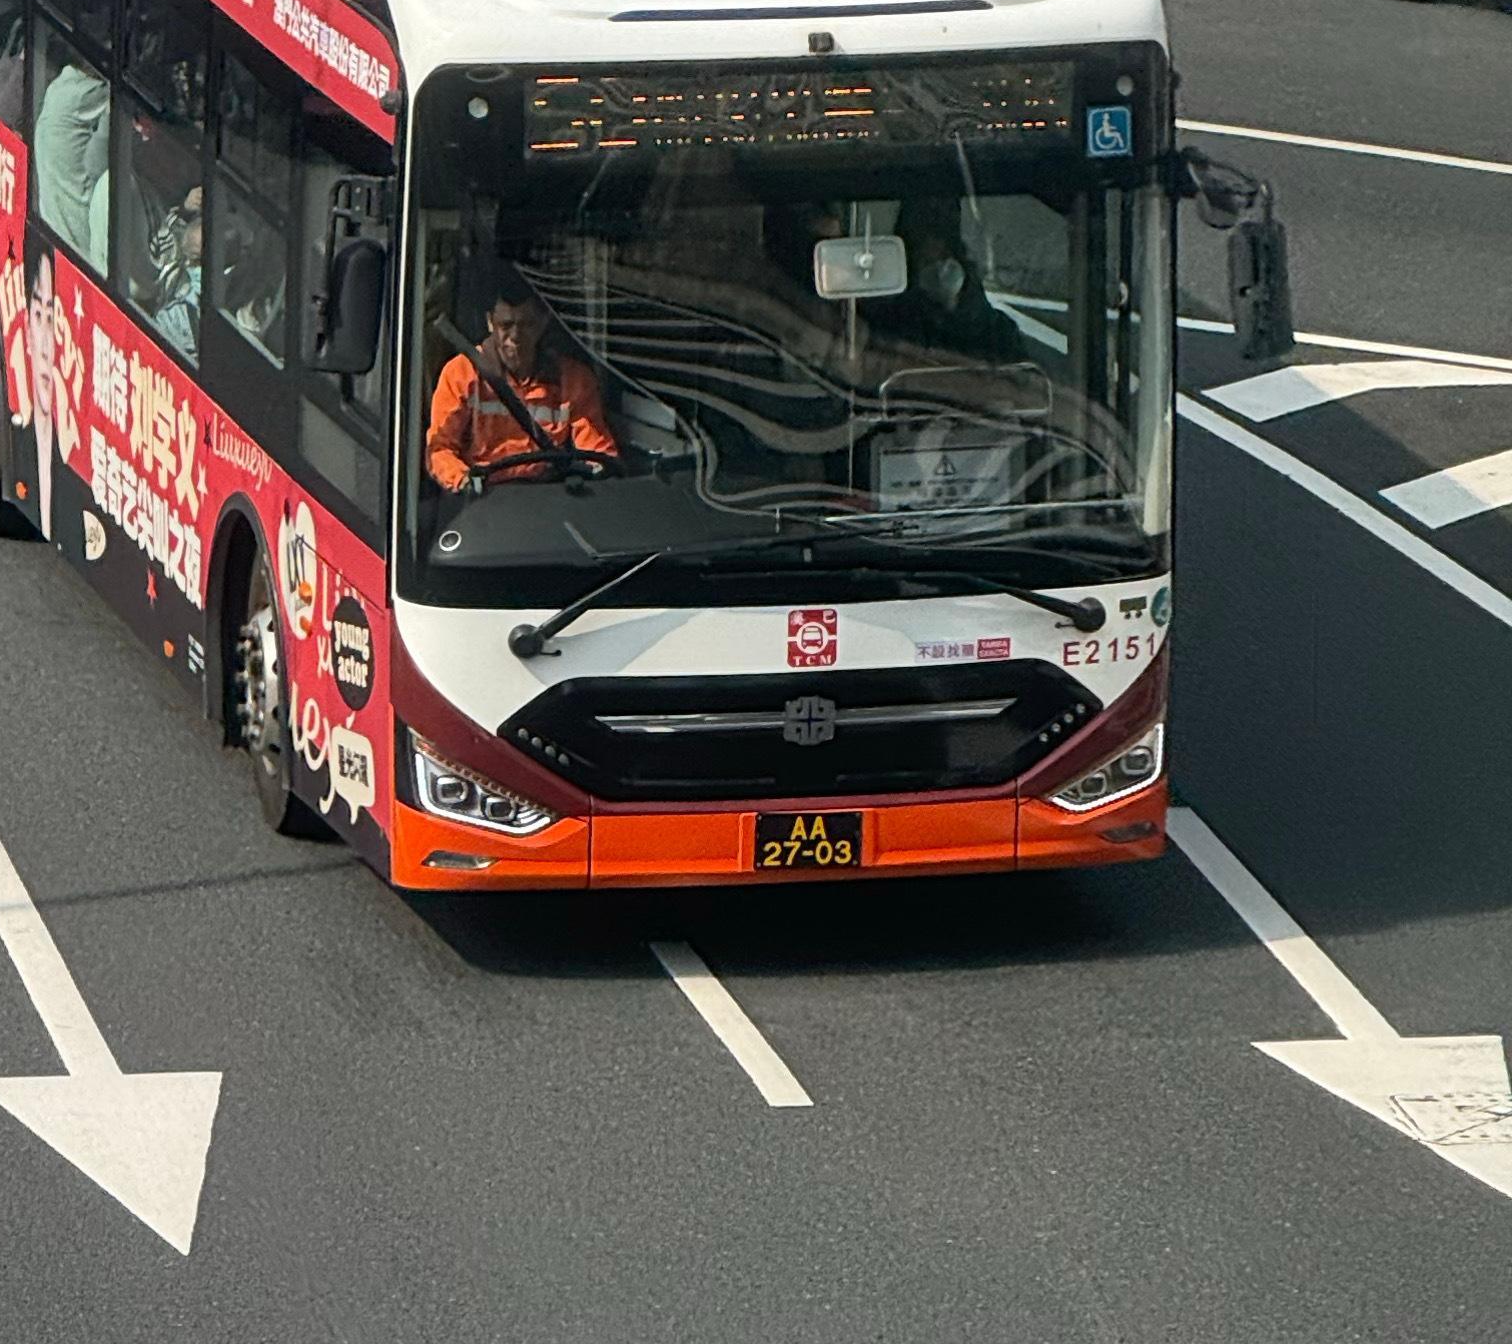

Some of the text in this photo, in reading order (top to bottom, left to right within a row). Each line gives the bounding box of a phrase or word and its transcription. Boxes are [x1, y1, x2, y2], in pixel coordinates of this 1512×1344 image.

[333, 620, 370, 661] young
[1062, 632, 1157, 667] E2151
[337, 655, 368, 688] actor
[792, 654, 832, 666] TCM
[790, 816, 828, 840] AA
[763, 840, 853, 867] 27-03
